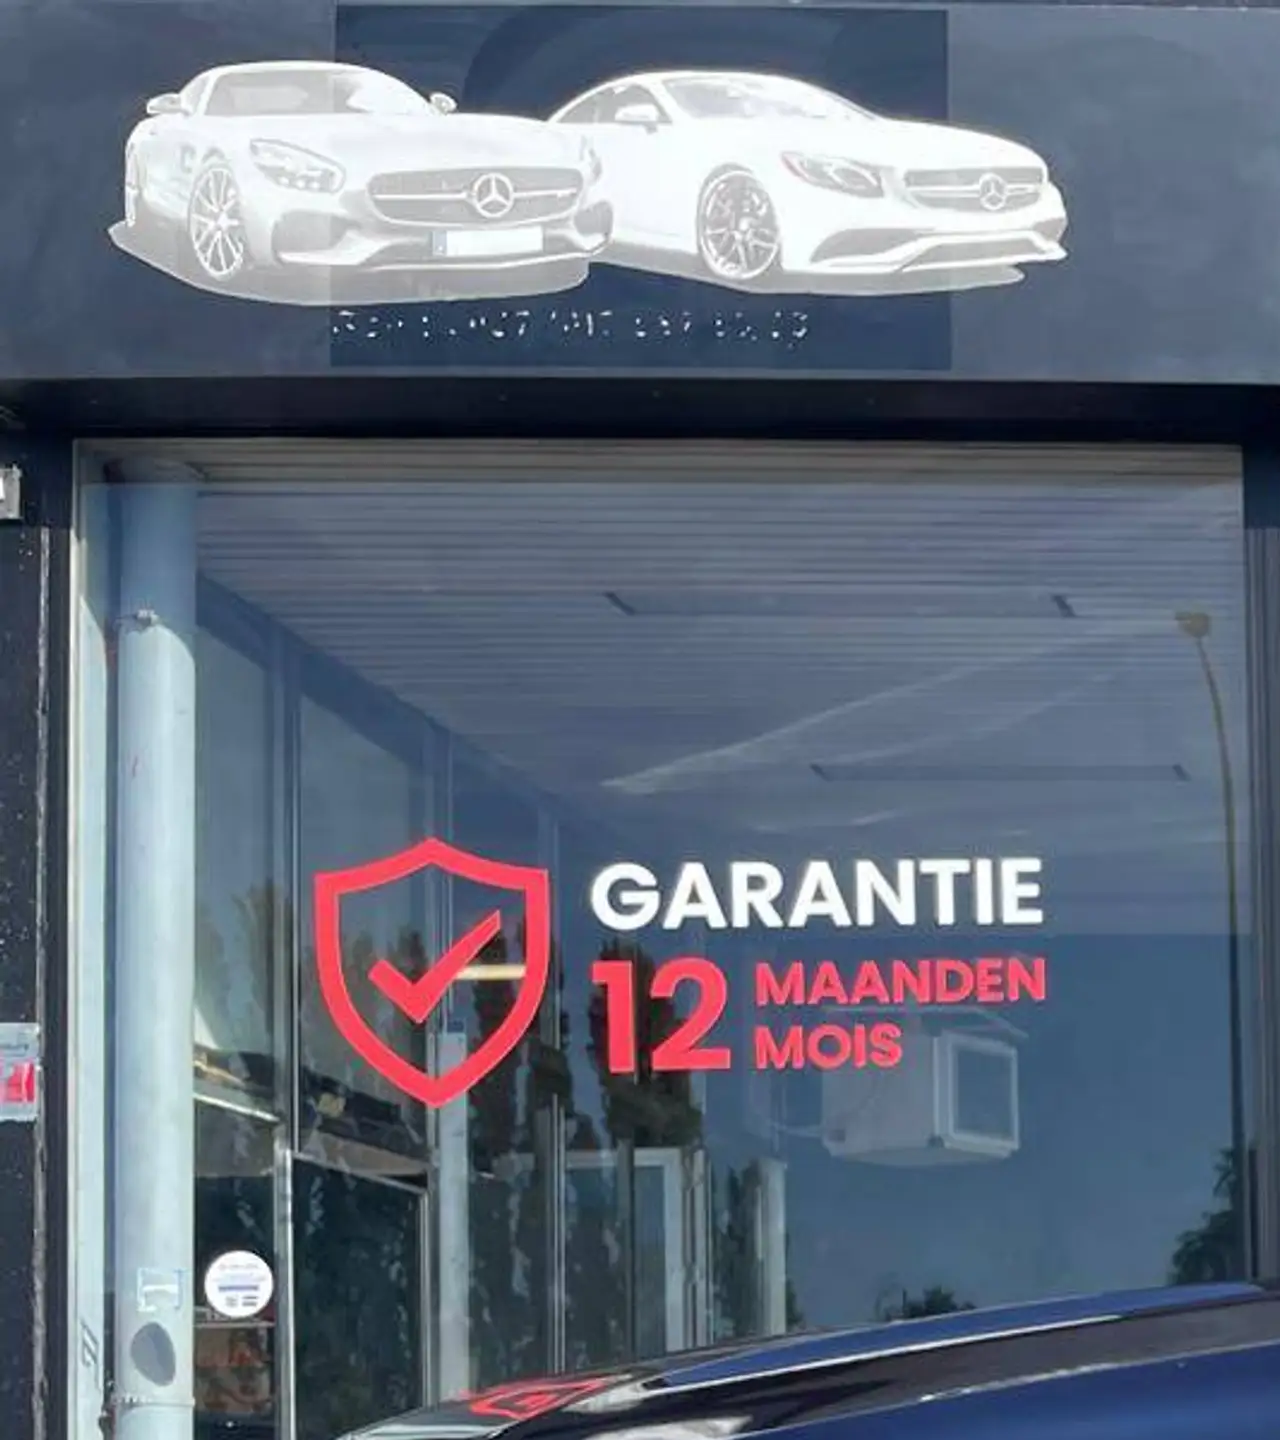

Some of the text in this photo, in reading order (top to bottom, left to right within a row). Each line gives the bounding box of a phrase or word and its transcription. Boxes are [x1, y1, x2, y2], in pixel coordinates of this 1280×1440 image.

[590, 856, 1045, 932] GARANTIE
[754, 957, 1047, 1008] MAANDEN
[590, 956, 732, 1075] 12
[753, 1022, 904, 1070] MOIS
